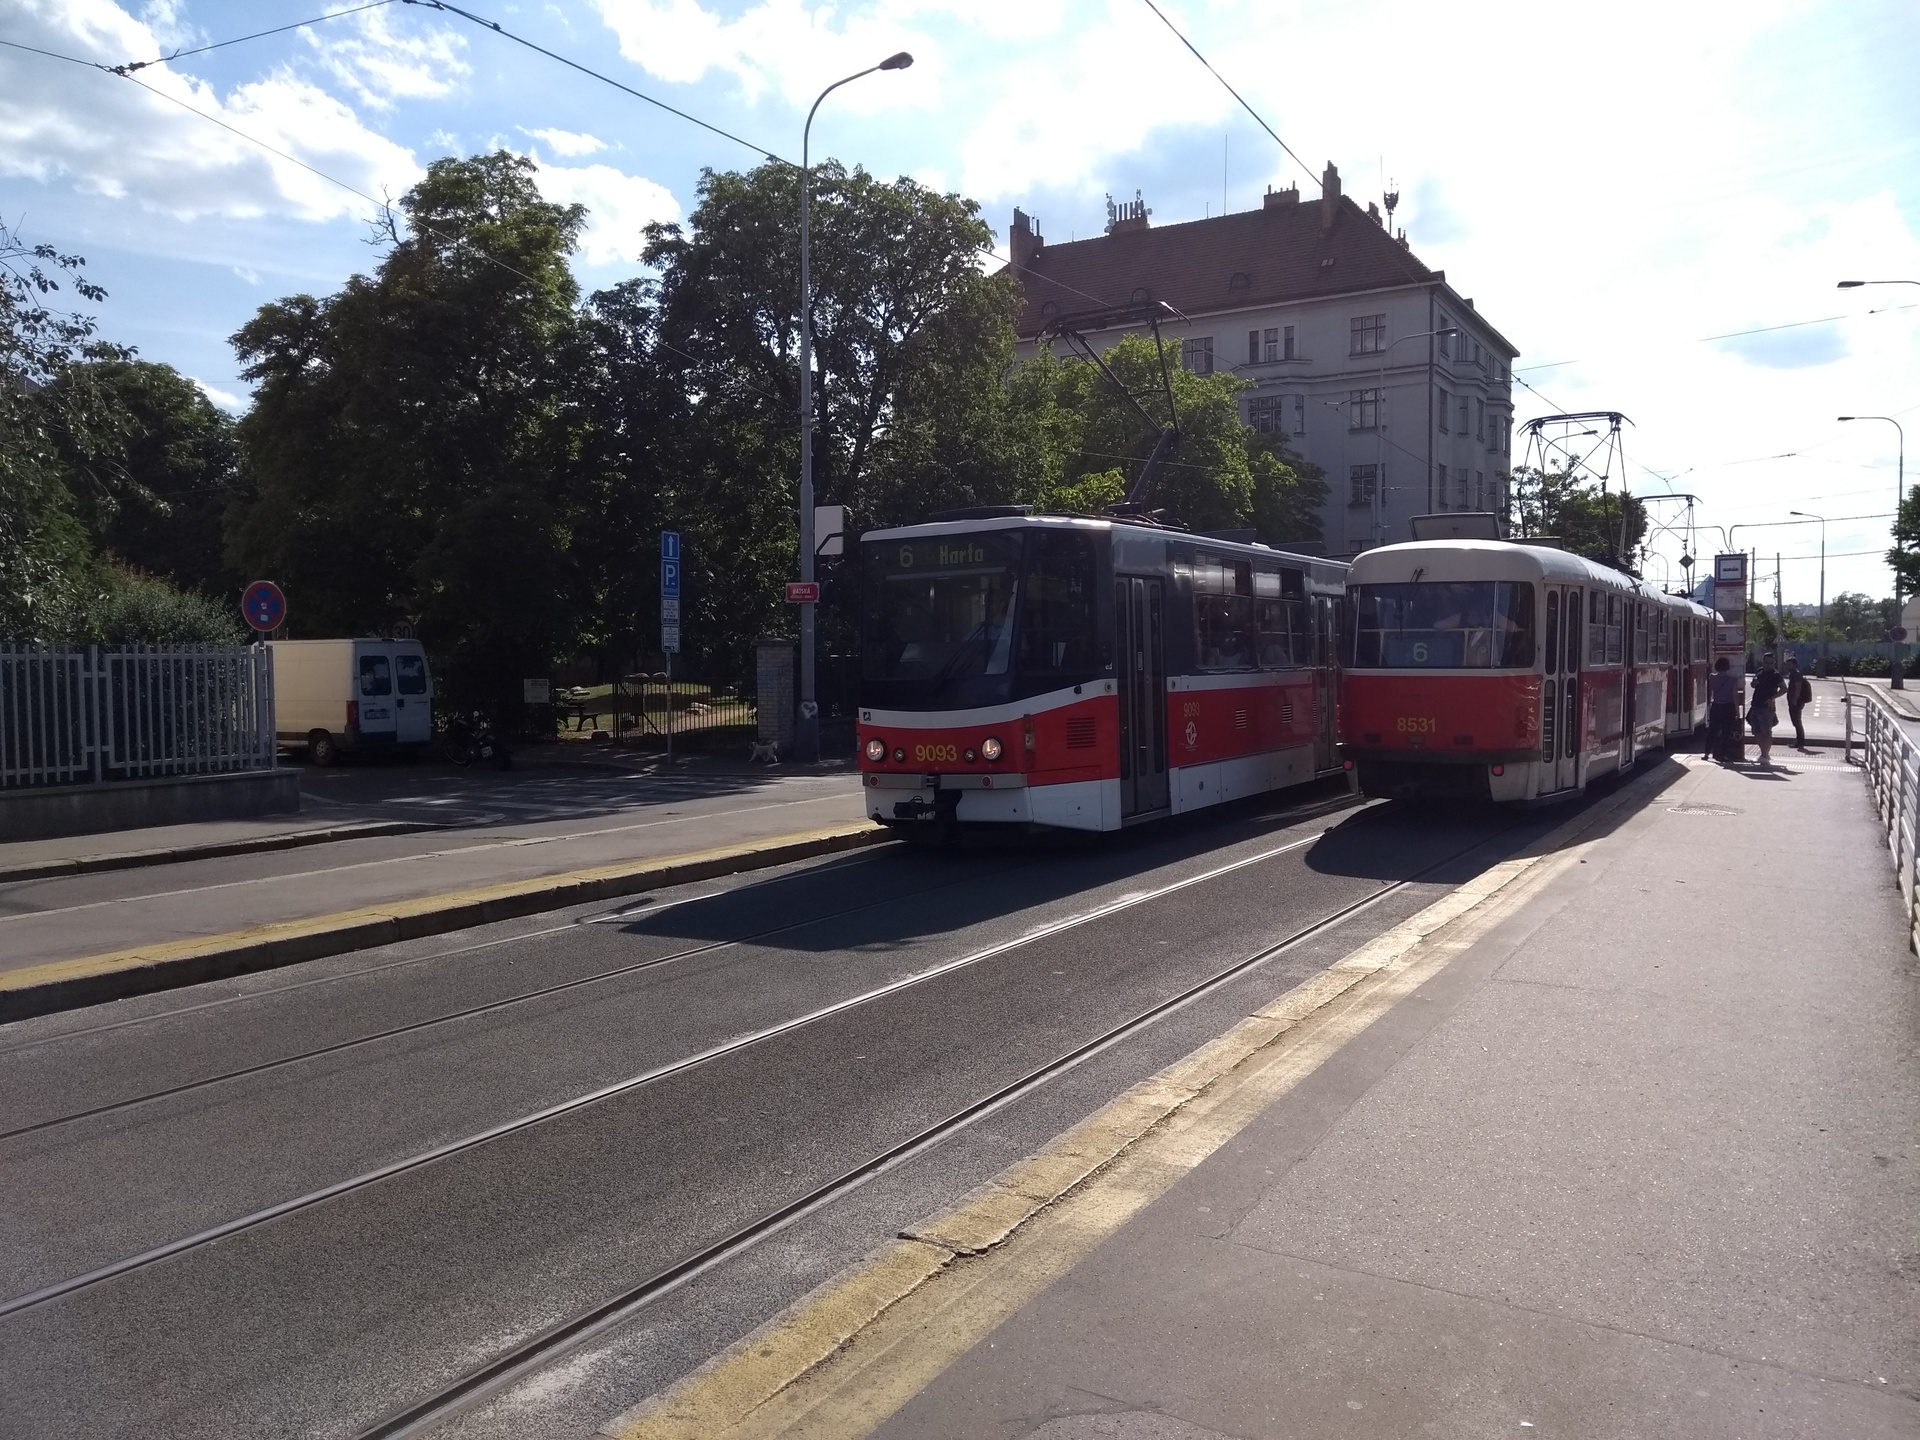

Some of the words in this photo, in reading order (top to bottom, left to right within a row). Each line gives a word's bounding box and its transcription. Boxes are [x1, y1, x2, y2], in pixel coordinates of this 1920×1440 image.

[899, 544, 914, 568] 6
[939, 542, 984, 565] Harfa
[665, 564, 676, 585] P
[792, 587, 811, 595] RAJSKÁ
[393, 626, 410, 639] 30
[1413, 641, 1428, 662] 6
[1183, 701, 1200, 717] 9093
[1396, 717, 1436, 733] 8531
[915, 744, 958, 762] 9093
